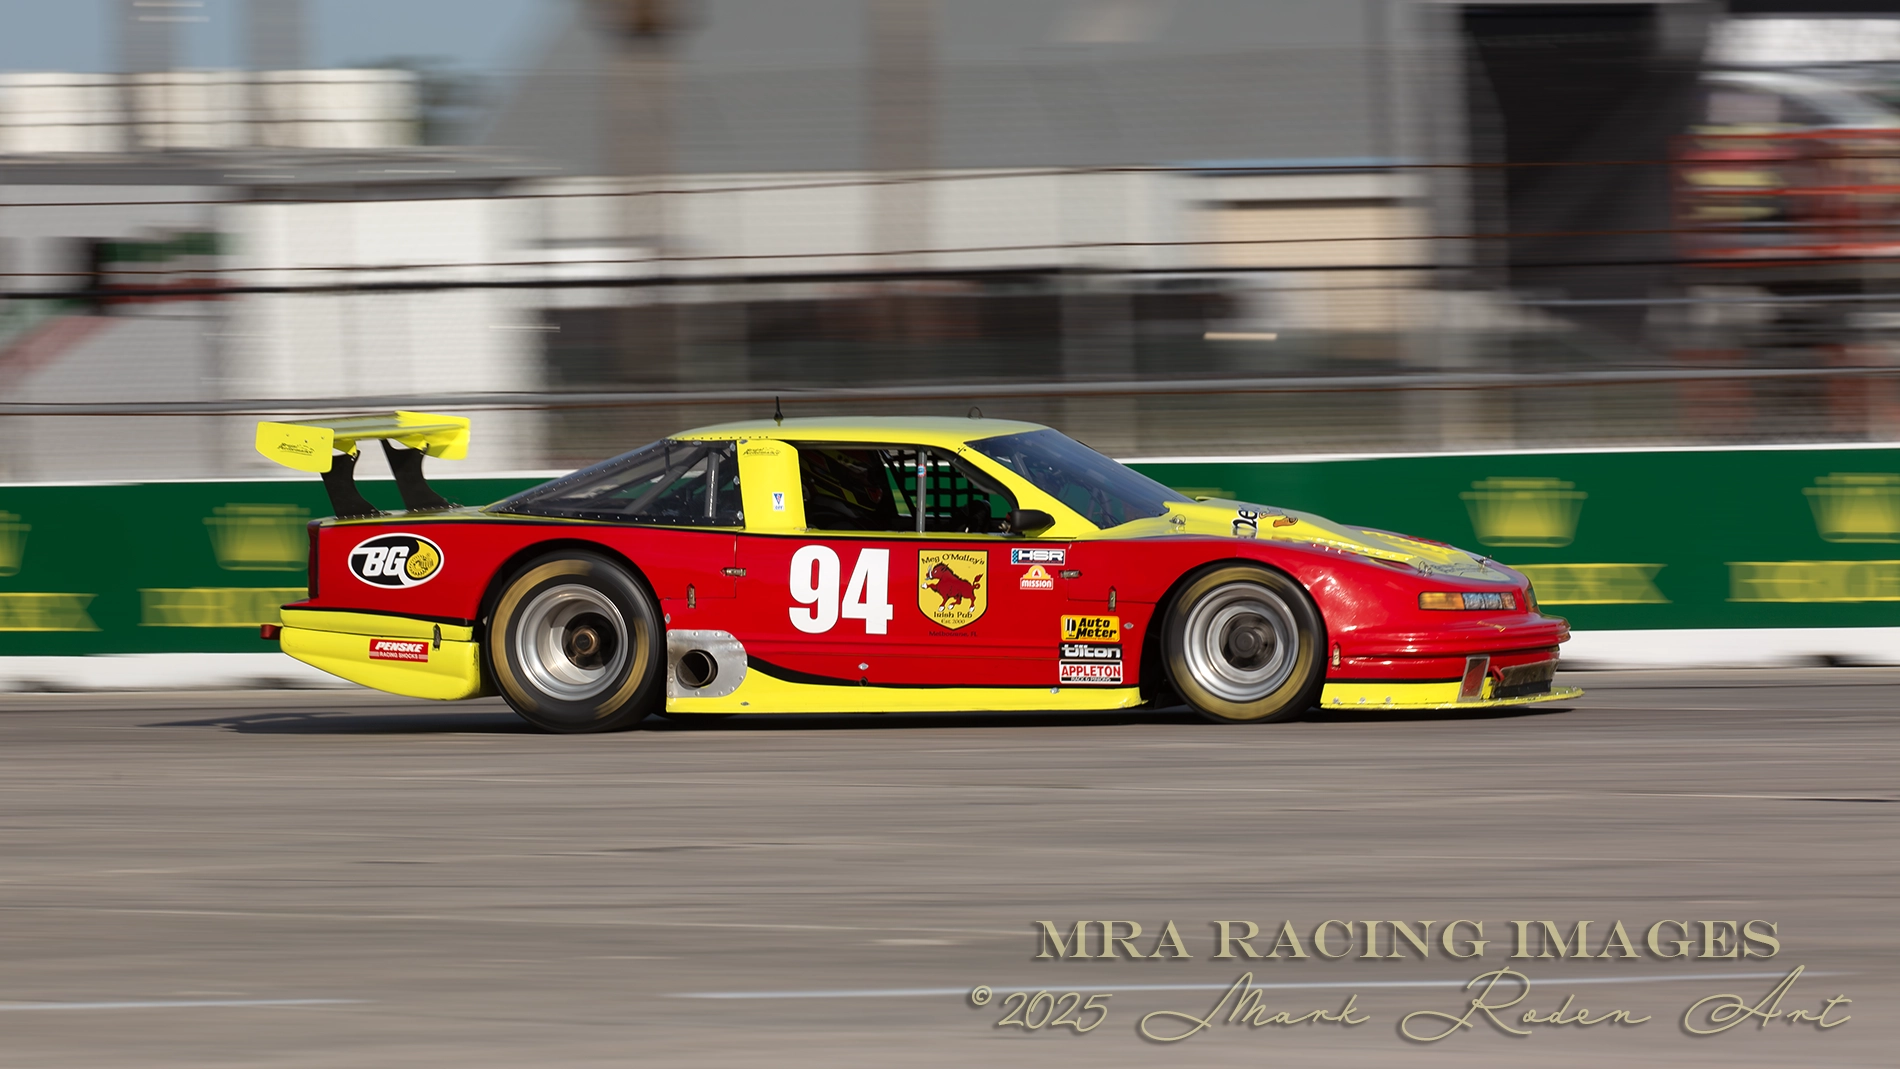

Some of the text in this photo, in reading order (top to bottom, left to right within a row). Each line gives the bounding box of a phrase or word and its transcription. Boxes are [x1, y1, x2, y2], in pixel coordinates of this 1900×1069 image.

[362, 546, 409, 576] BG
[921, 553, 985, 565] Meg O'Malley's
[1018, 550, 1064, 561] HSR
[789, 544, 893, 635] 94
[1079, 618, 1110, 628] Auto
[1076, 627, 1117, 639] Meter
[375, 641, 424, 653] PENSKE
[1061, 644, 1121, 658] tilton
[1061, 665, 1121, 677] APPLETON
